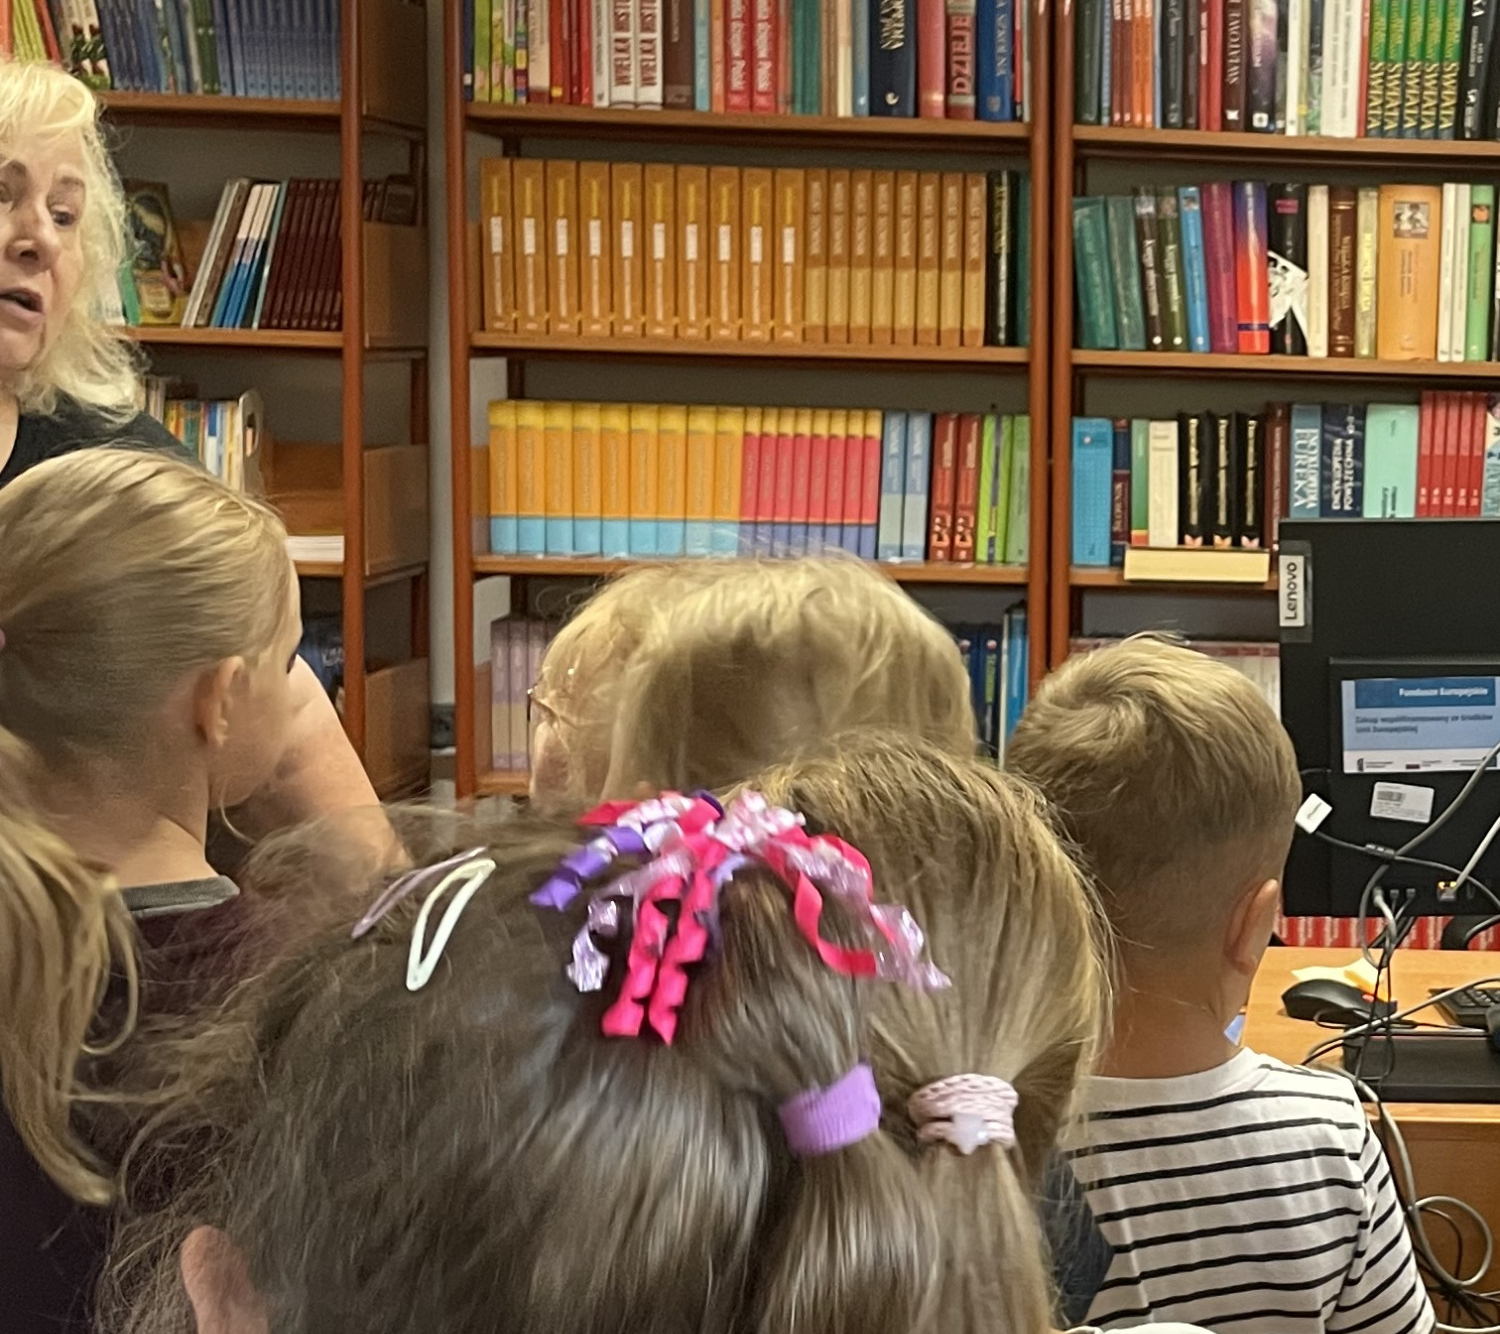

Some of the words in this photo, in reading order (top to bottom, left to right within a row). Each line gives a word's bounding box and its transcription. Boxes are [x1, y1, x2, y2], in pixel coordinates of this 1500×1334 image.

[952, 15, 972, 95] DZIEJE
[1492, 426, 1500, 436] 3
[1293, 428, 1308, 508] EUREKA
[1284, 561, 1298, 621] Lenovo
